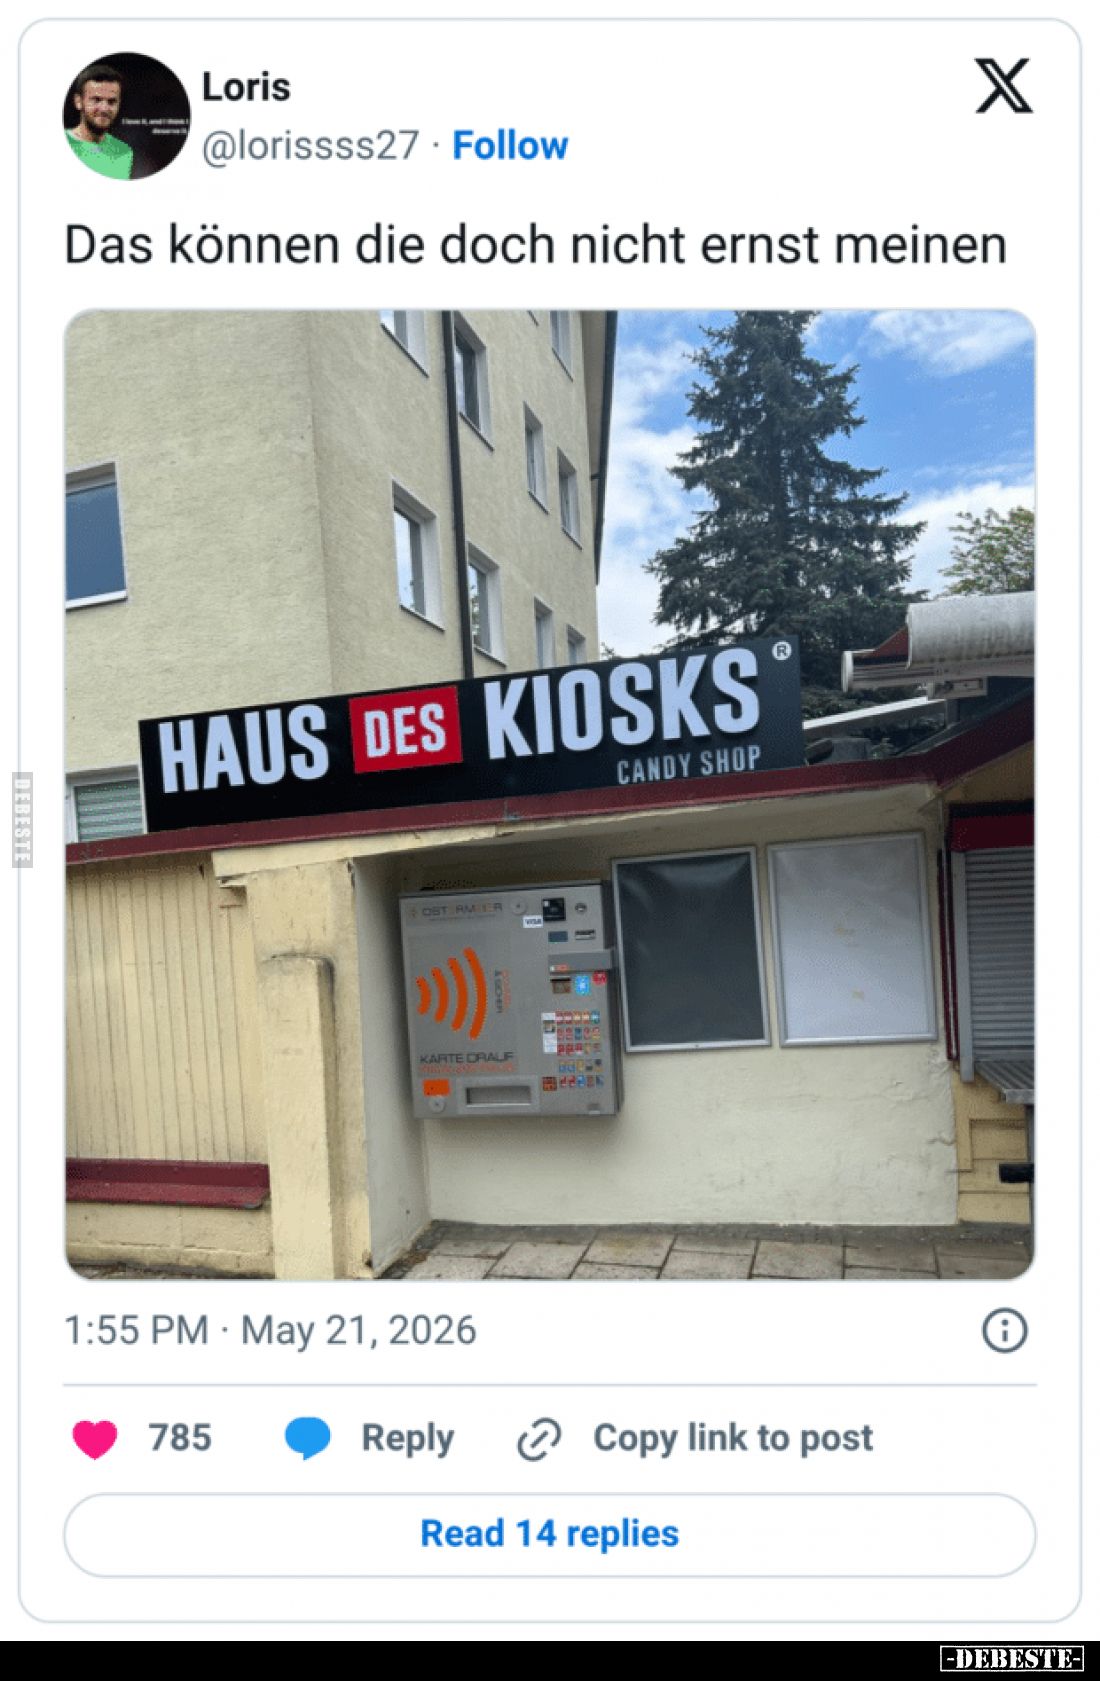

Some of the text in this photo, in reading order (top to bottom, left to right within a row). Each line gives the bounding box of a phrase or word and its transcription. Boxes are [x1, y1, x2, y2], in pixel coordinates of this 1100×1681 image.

[158, 703, 330, 794] HAUS
[364, 702, 447, 758] DES
[484, 648, 760, 760] KIOSKS
[616, 745, 761, 785] CANDY SHOP
